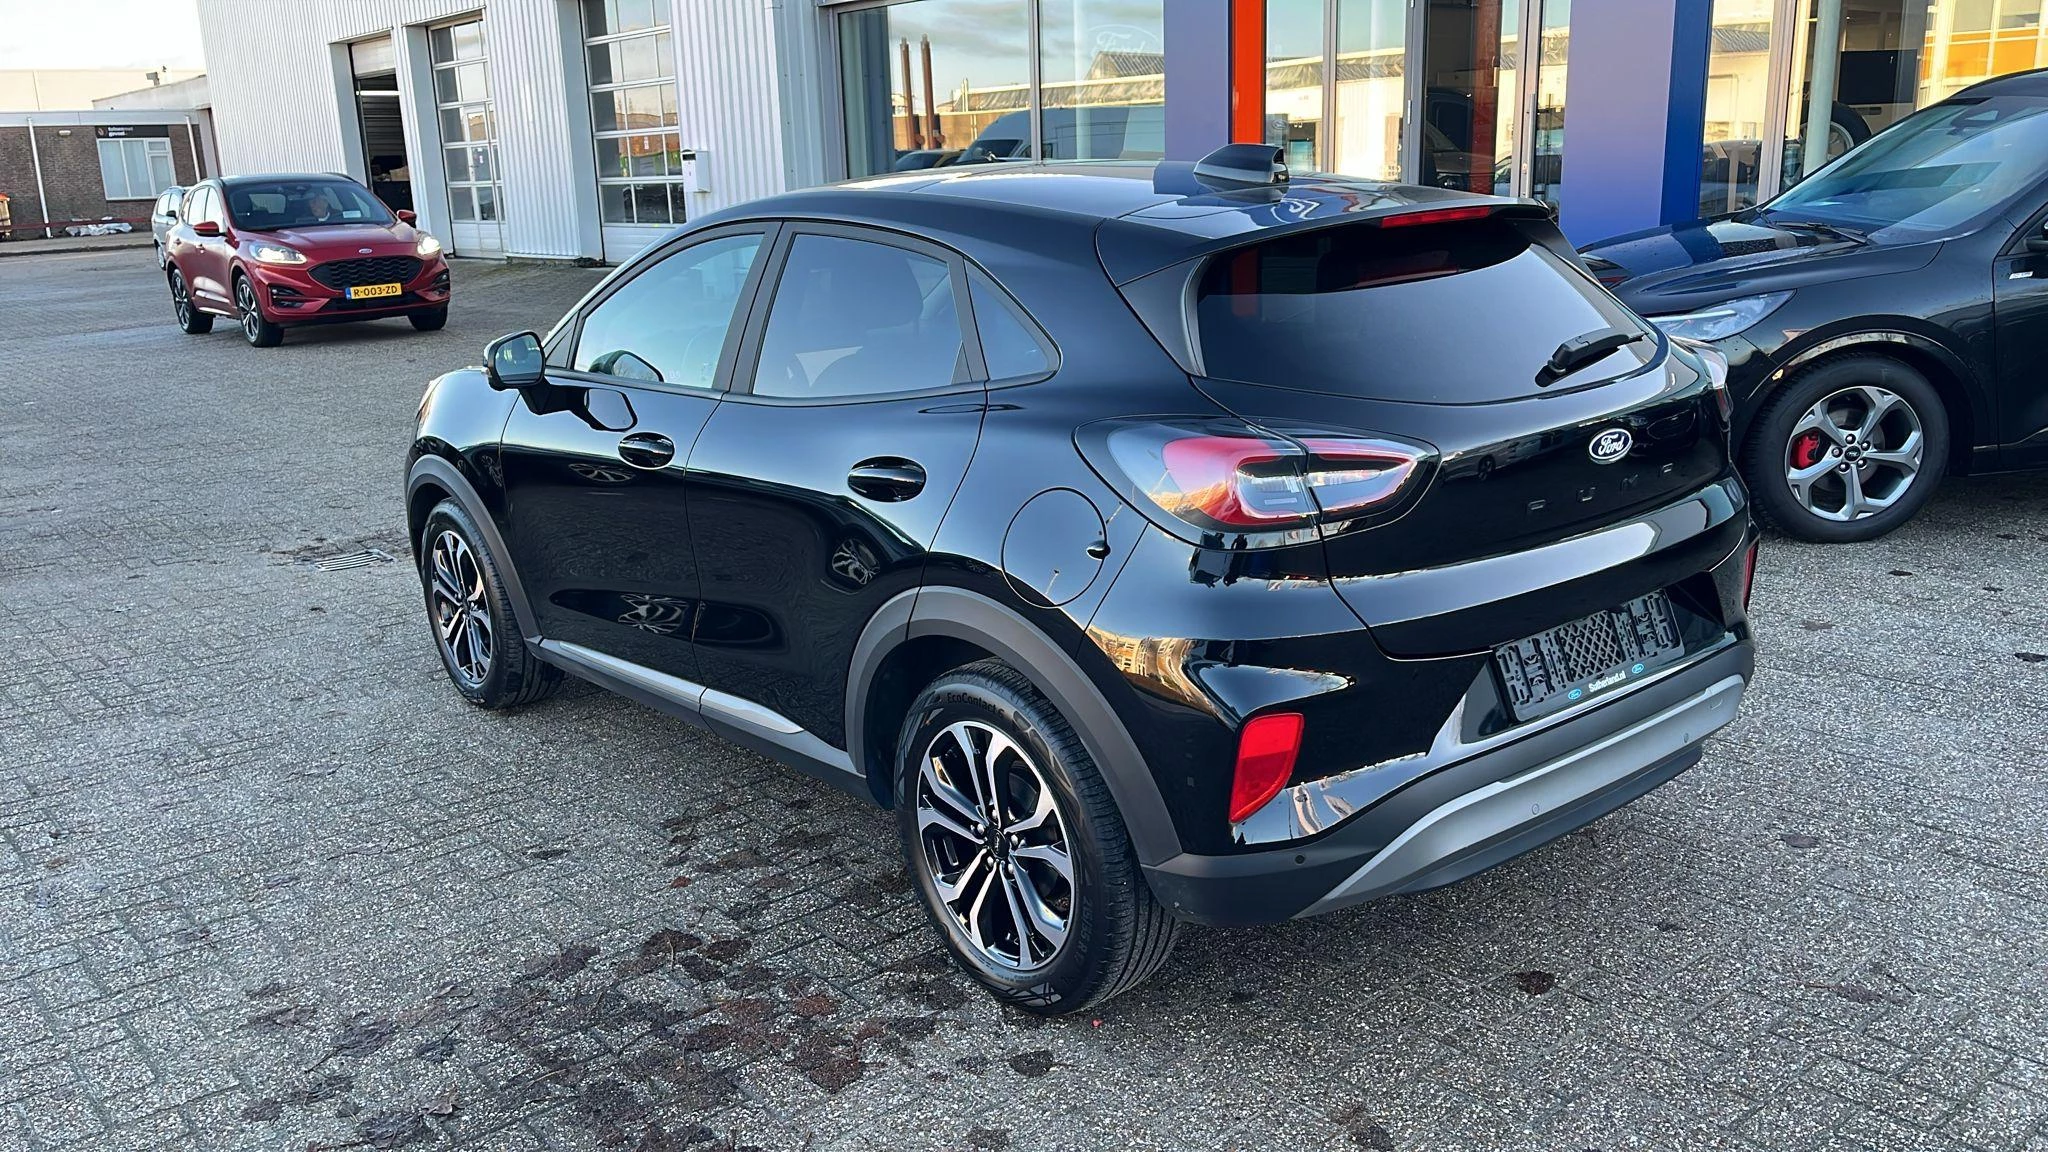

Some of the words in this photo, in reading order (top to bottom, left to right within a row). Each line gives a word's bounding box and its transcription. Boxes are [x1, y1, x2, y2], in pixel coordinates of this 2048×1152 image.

[353, 285, 398, 297] R-003-ZD
[1597, 434, 1626, 456] Ford
[946, 692, 996, 714] EcoContact
